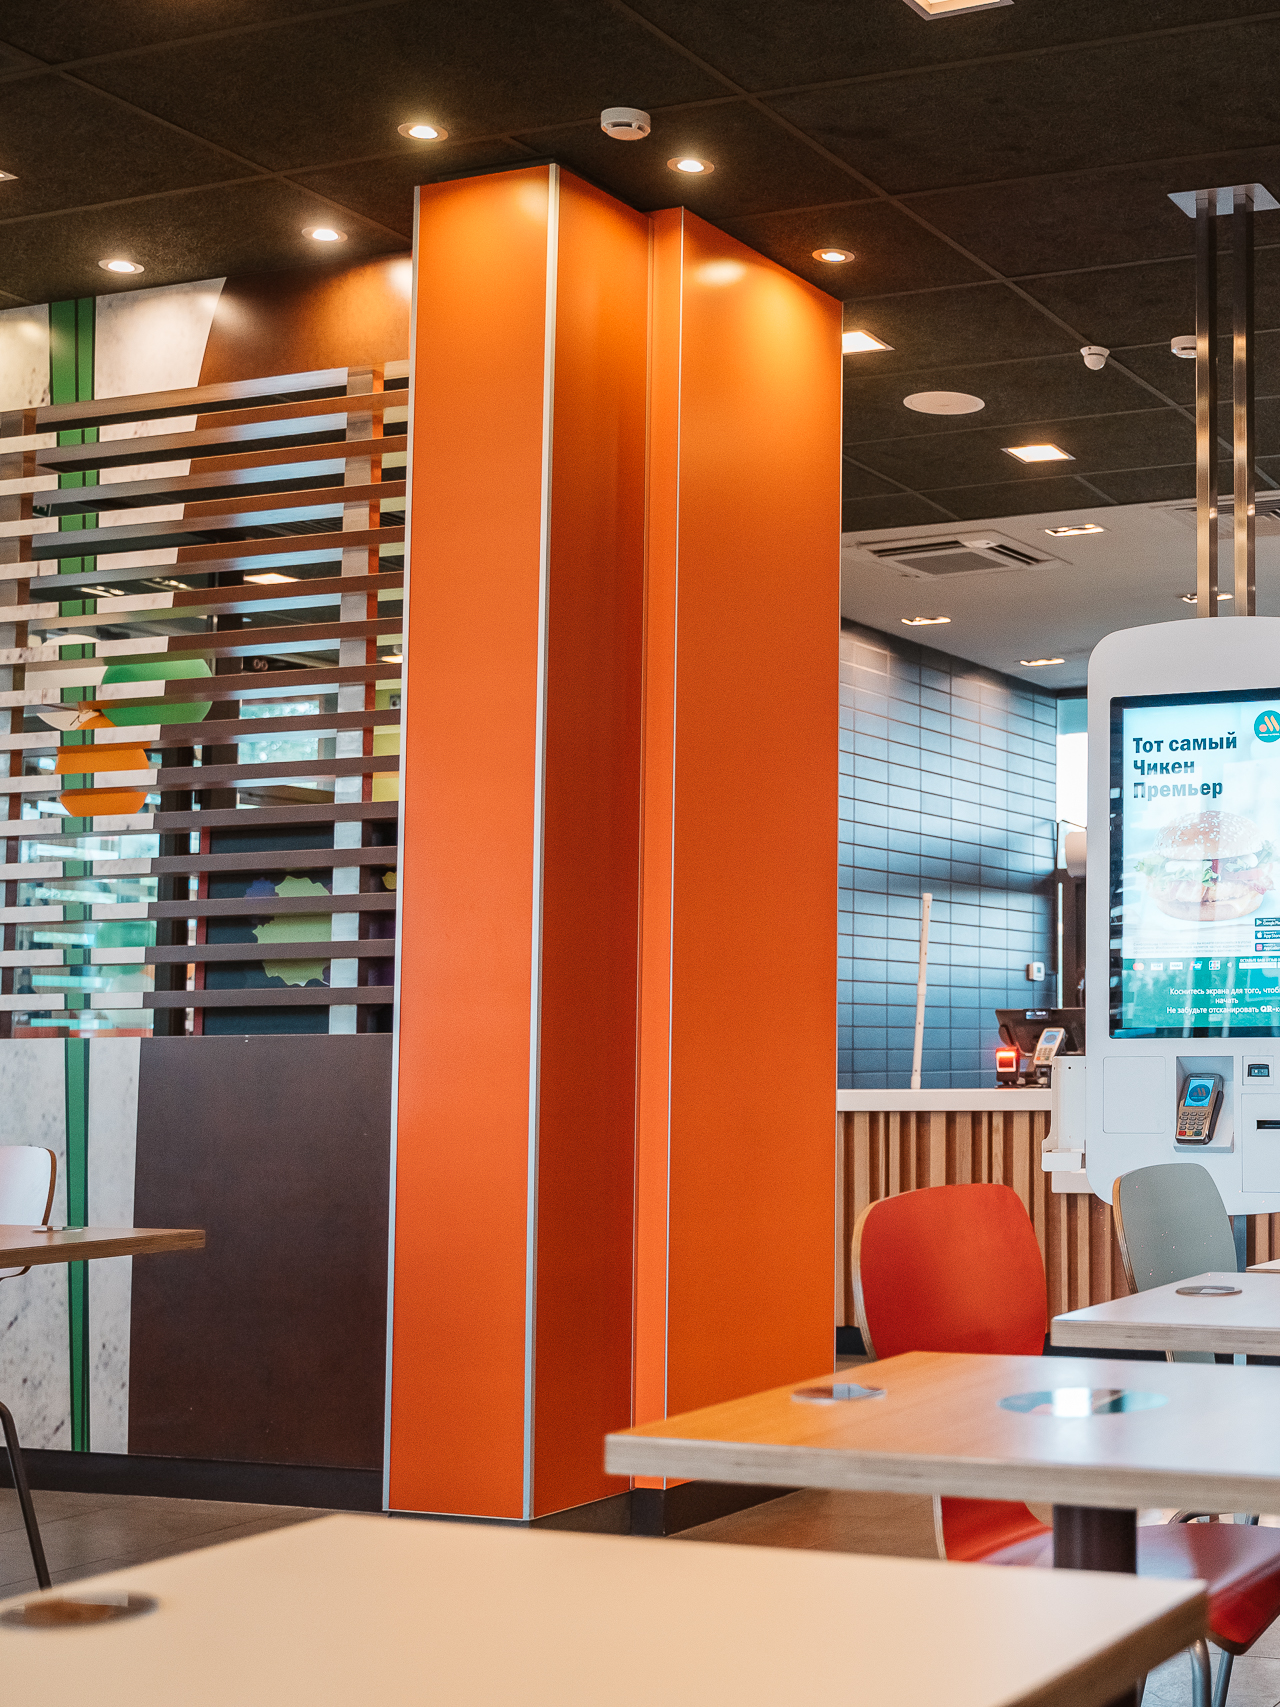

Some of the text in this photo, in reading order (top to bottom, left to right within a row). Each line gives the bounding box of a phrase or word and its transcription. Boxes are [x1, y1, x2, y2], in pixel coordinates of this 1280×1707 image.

[1132, 731, 1238, 754] Тот самый
[1133, 759, 1195, 776] Чикен
[1133, 781, 1224, 802] Премьер
[1205, 988, 1230, 997] экрана
[1230, 988, 1243, 996] для
[1166, 1006, 1176, 1014] Не
[1177, 1006, 1208, 1015] забудьте
[1208, 1006, 1260, 1015] отсканировать
